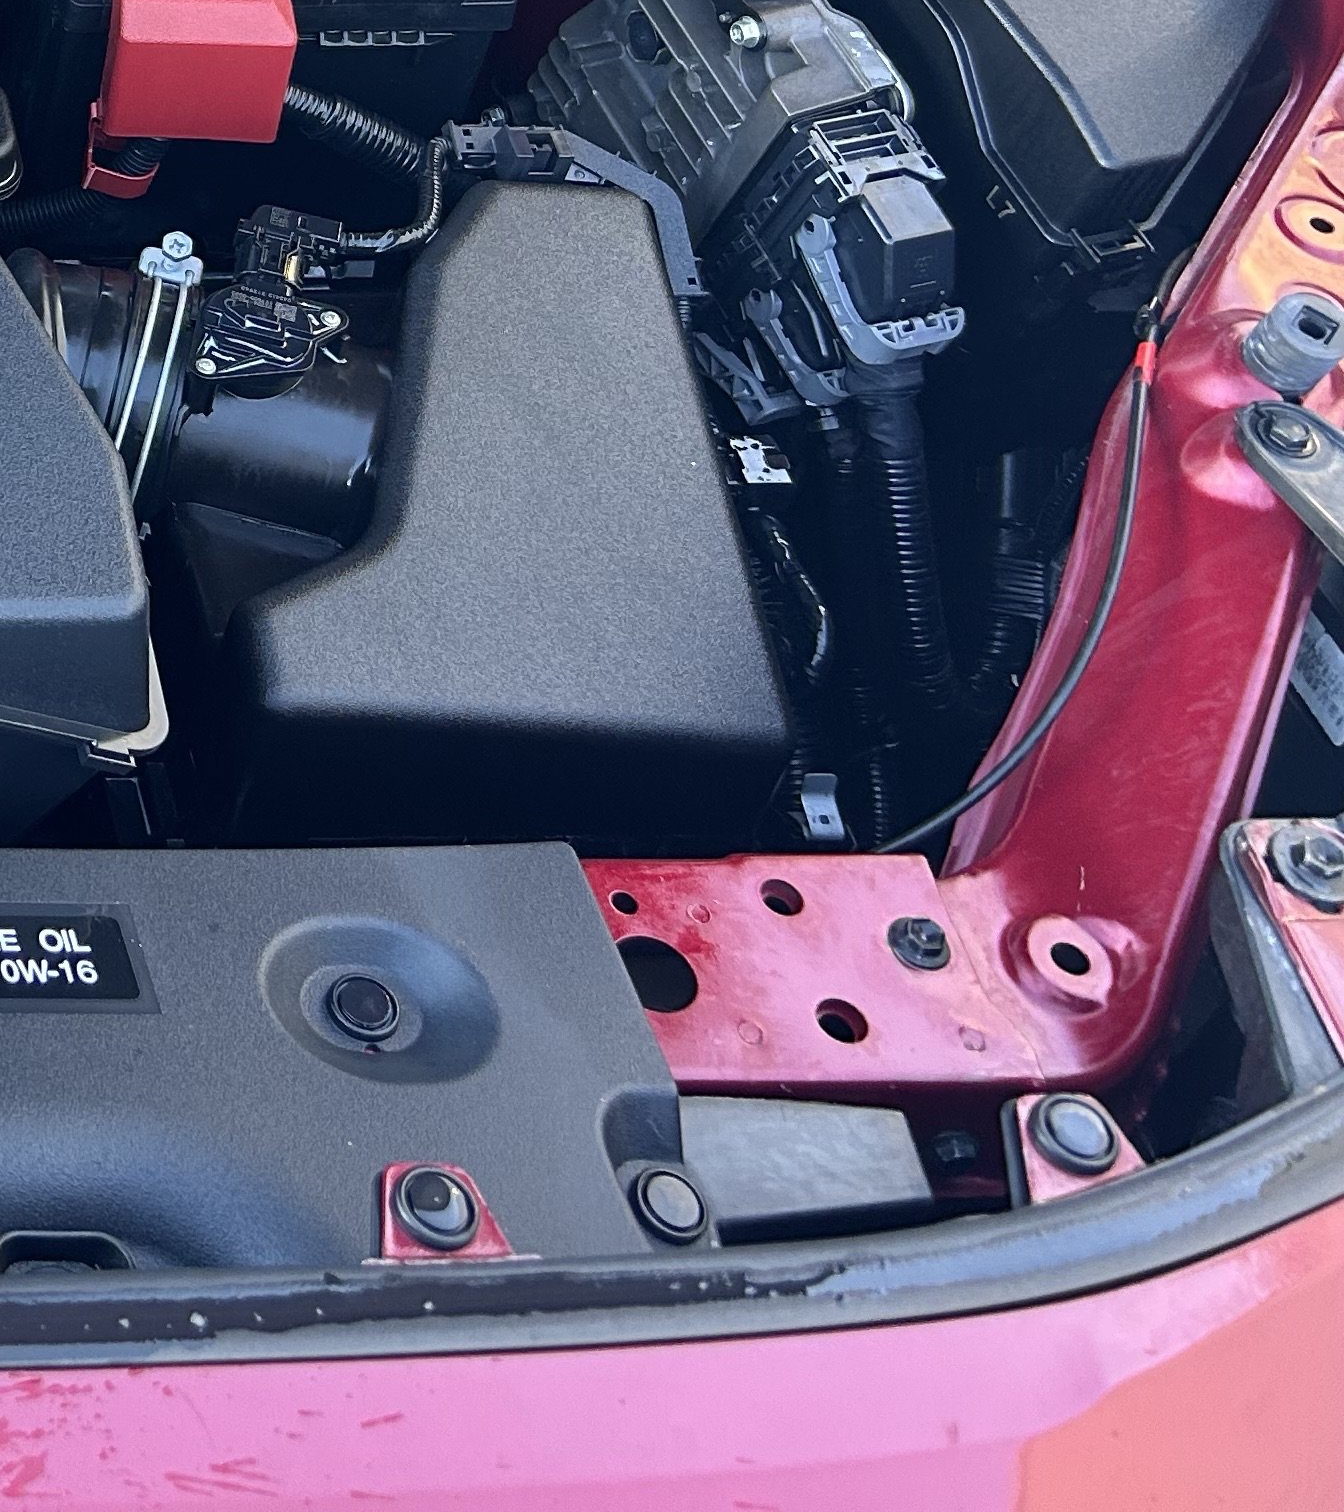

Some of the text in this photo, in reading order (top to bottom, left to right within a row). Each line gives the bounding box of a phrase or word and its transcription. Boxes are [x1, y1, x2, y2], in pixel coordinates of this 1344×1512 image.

[986, 184, 1016, 218] L7
[38, 928, 92, 953] OIL
[0, 958, 99, 985] 0W-16
